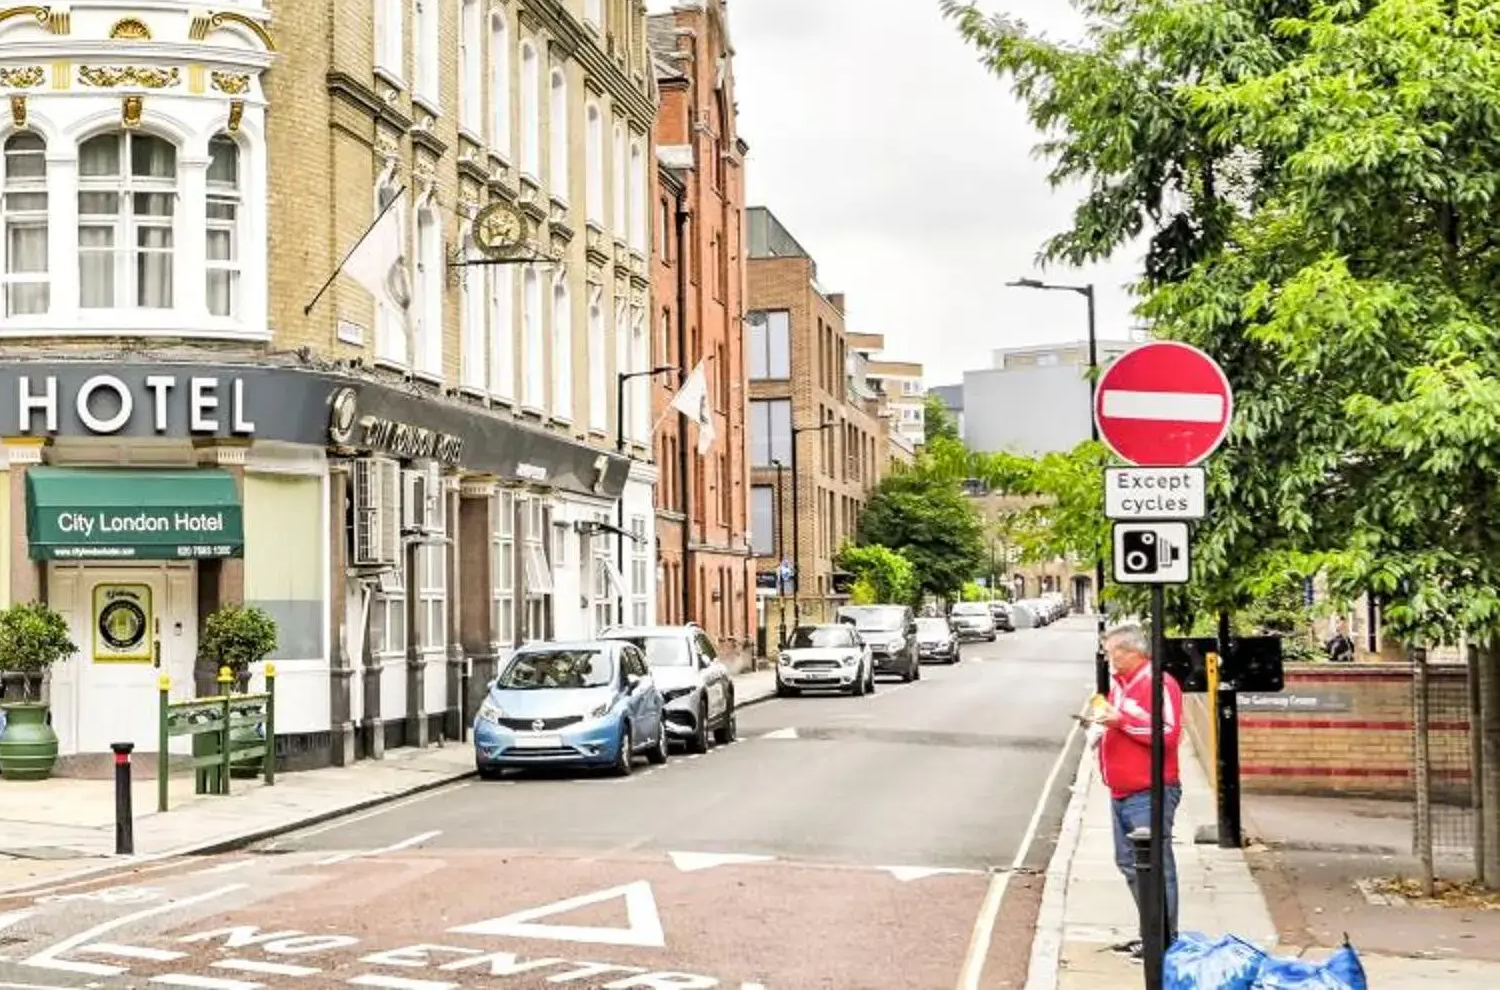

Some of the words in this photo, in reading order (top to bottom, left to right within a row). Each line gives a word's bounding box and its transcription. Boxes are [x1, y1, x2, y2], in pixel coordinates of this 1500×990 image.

[19, 374, 255, 433] HOTEL
[391, 423, 436, 456] LONDON
[1118, 473, 1191, 490] Except
[1122, 494, 1188, 514] cycles
[57, 513, 94, 536] City
[100, 513, 169, 532] London
[175, 513, 222, 532] Hotel
[179, 925, 359, 955] NO
[357, 943, 766, 990] ENTR
